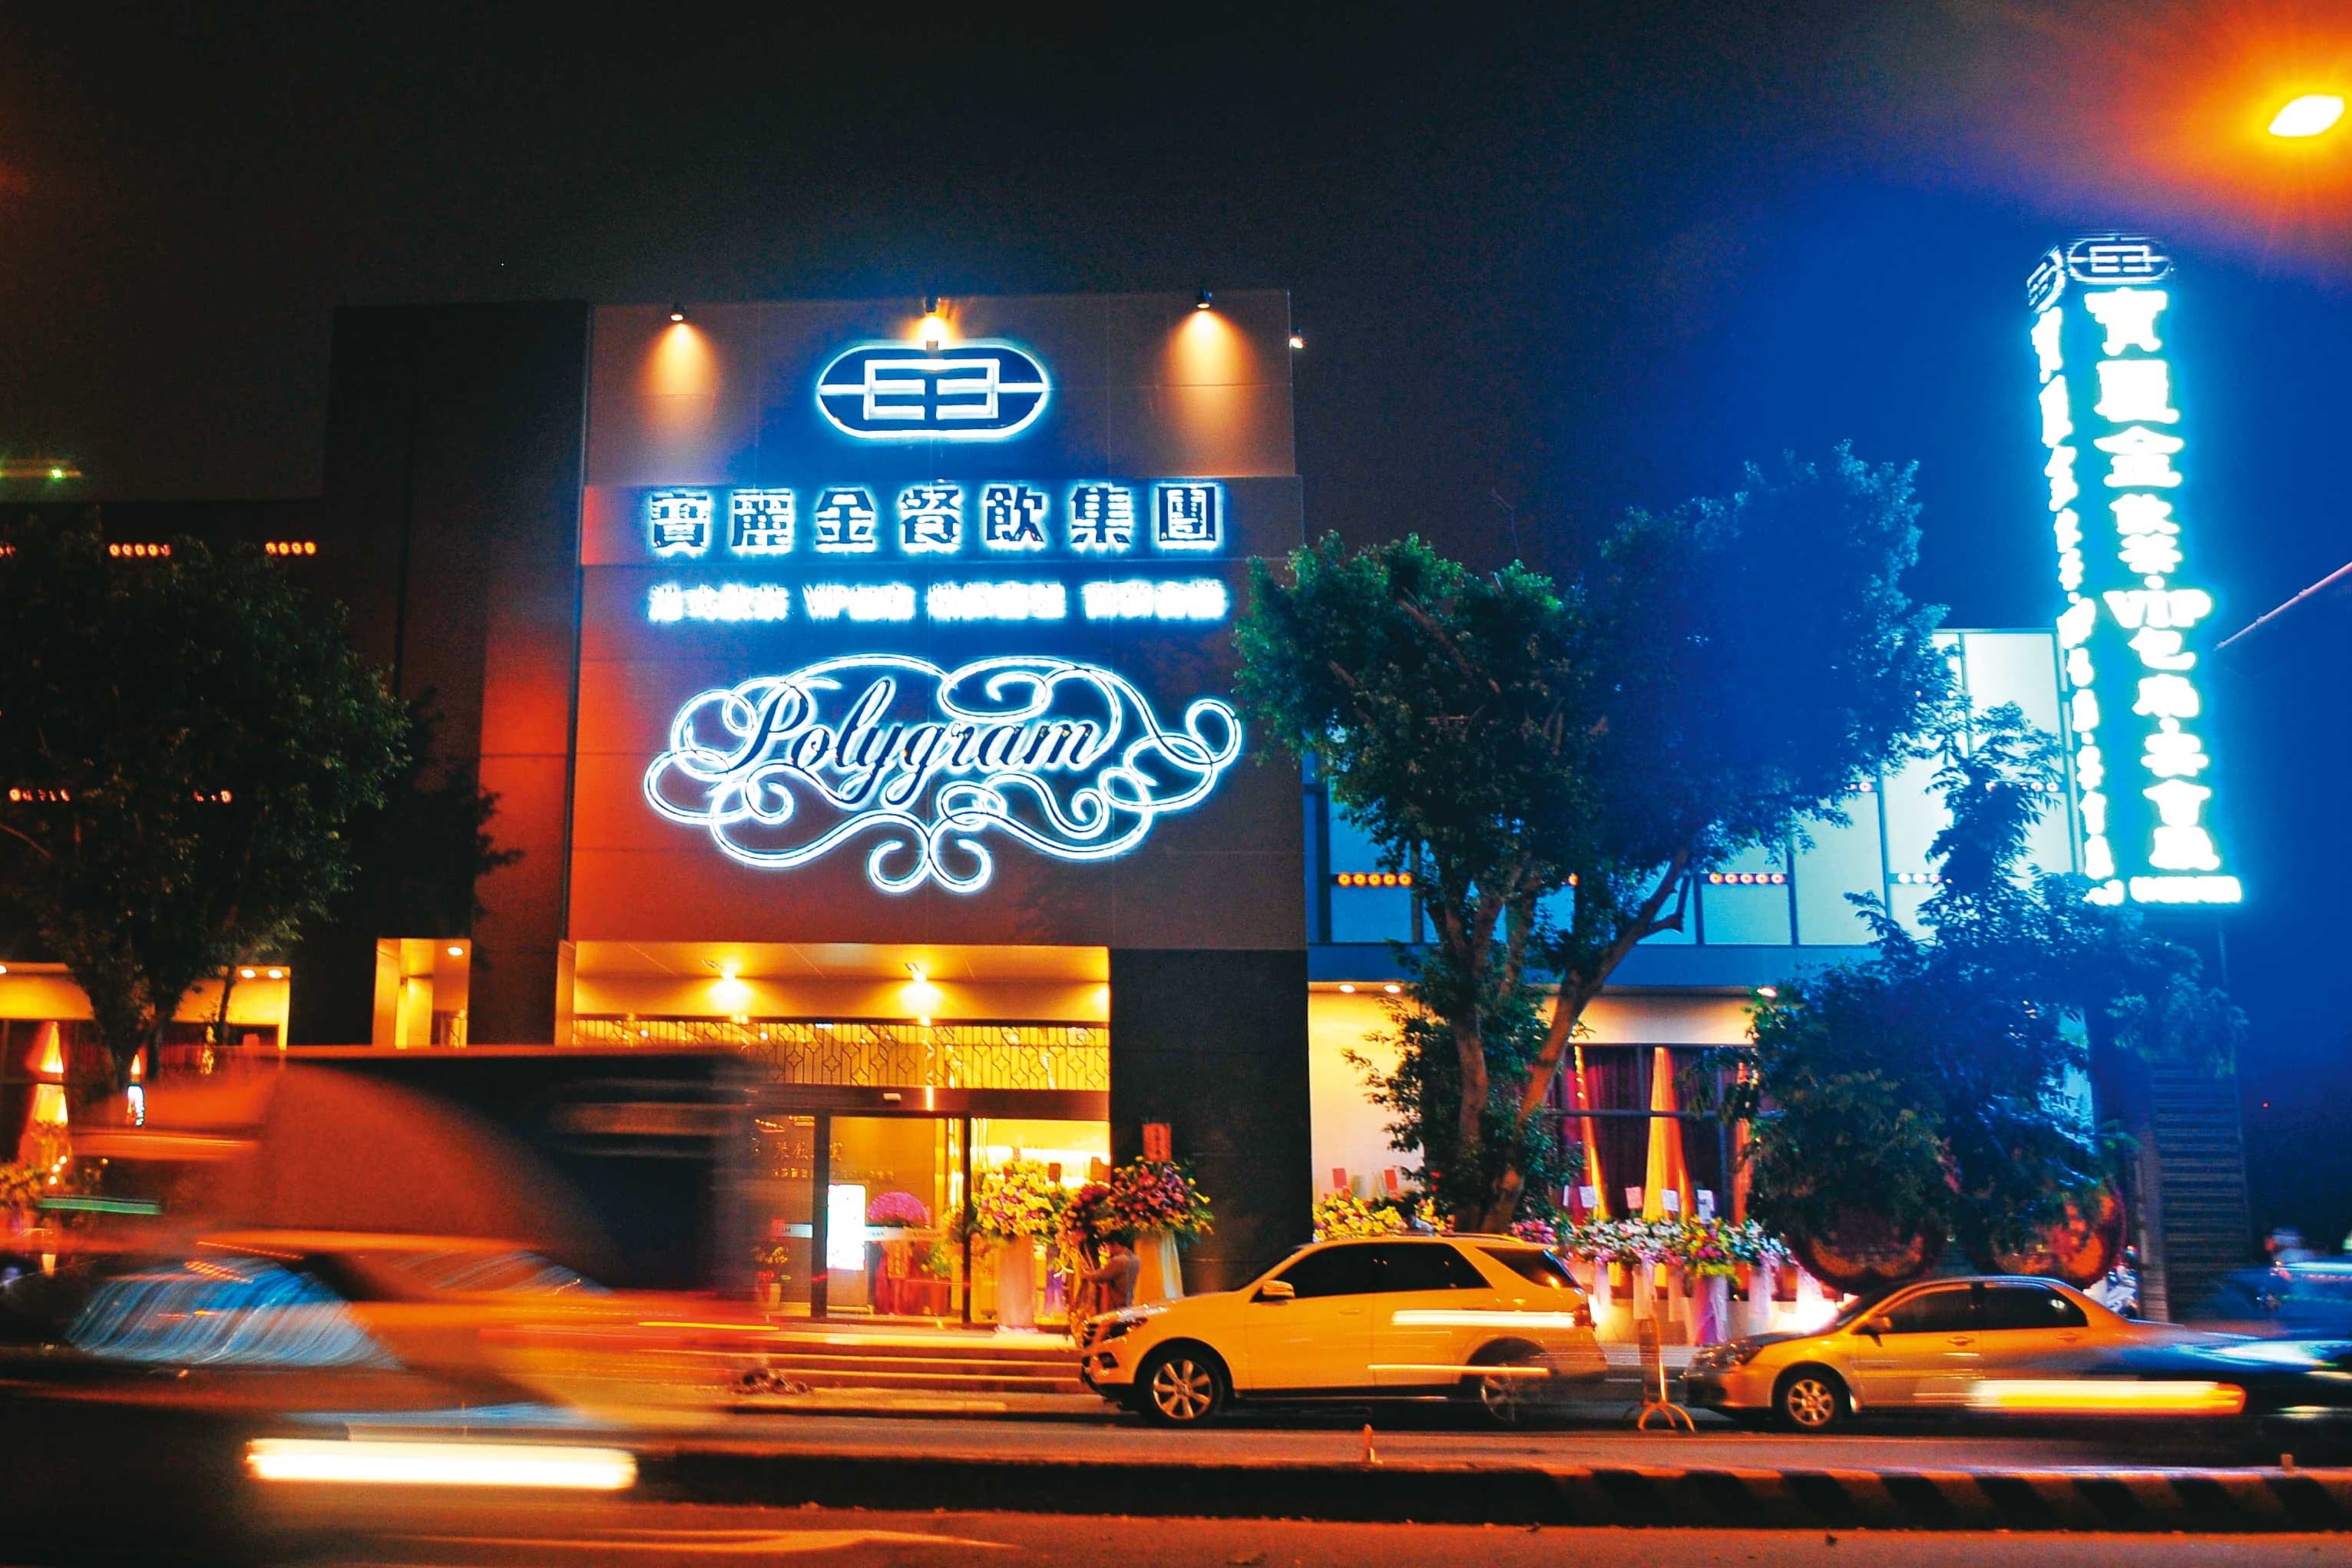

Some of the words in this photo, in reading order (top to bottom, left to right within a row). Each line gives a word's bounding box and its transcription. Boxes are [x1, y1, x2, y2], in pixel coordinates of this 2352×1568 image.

[650, 487, 1224, 554] 寶麗金餐飲集團
[725, 679, 1098, 806] Polygram
